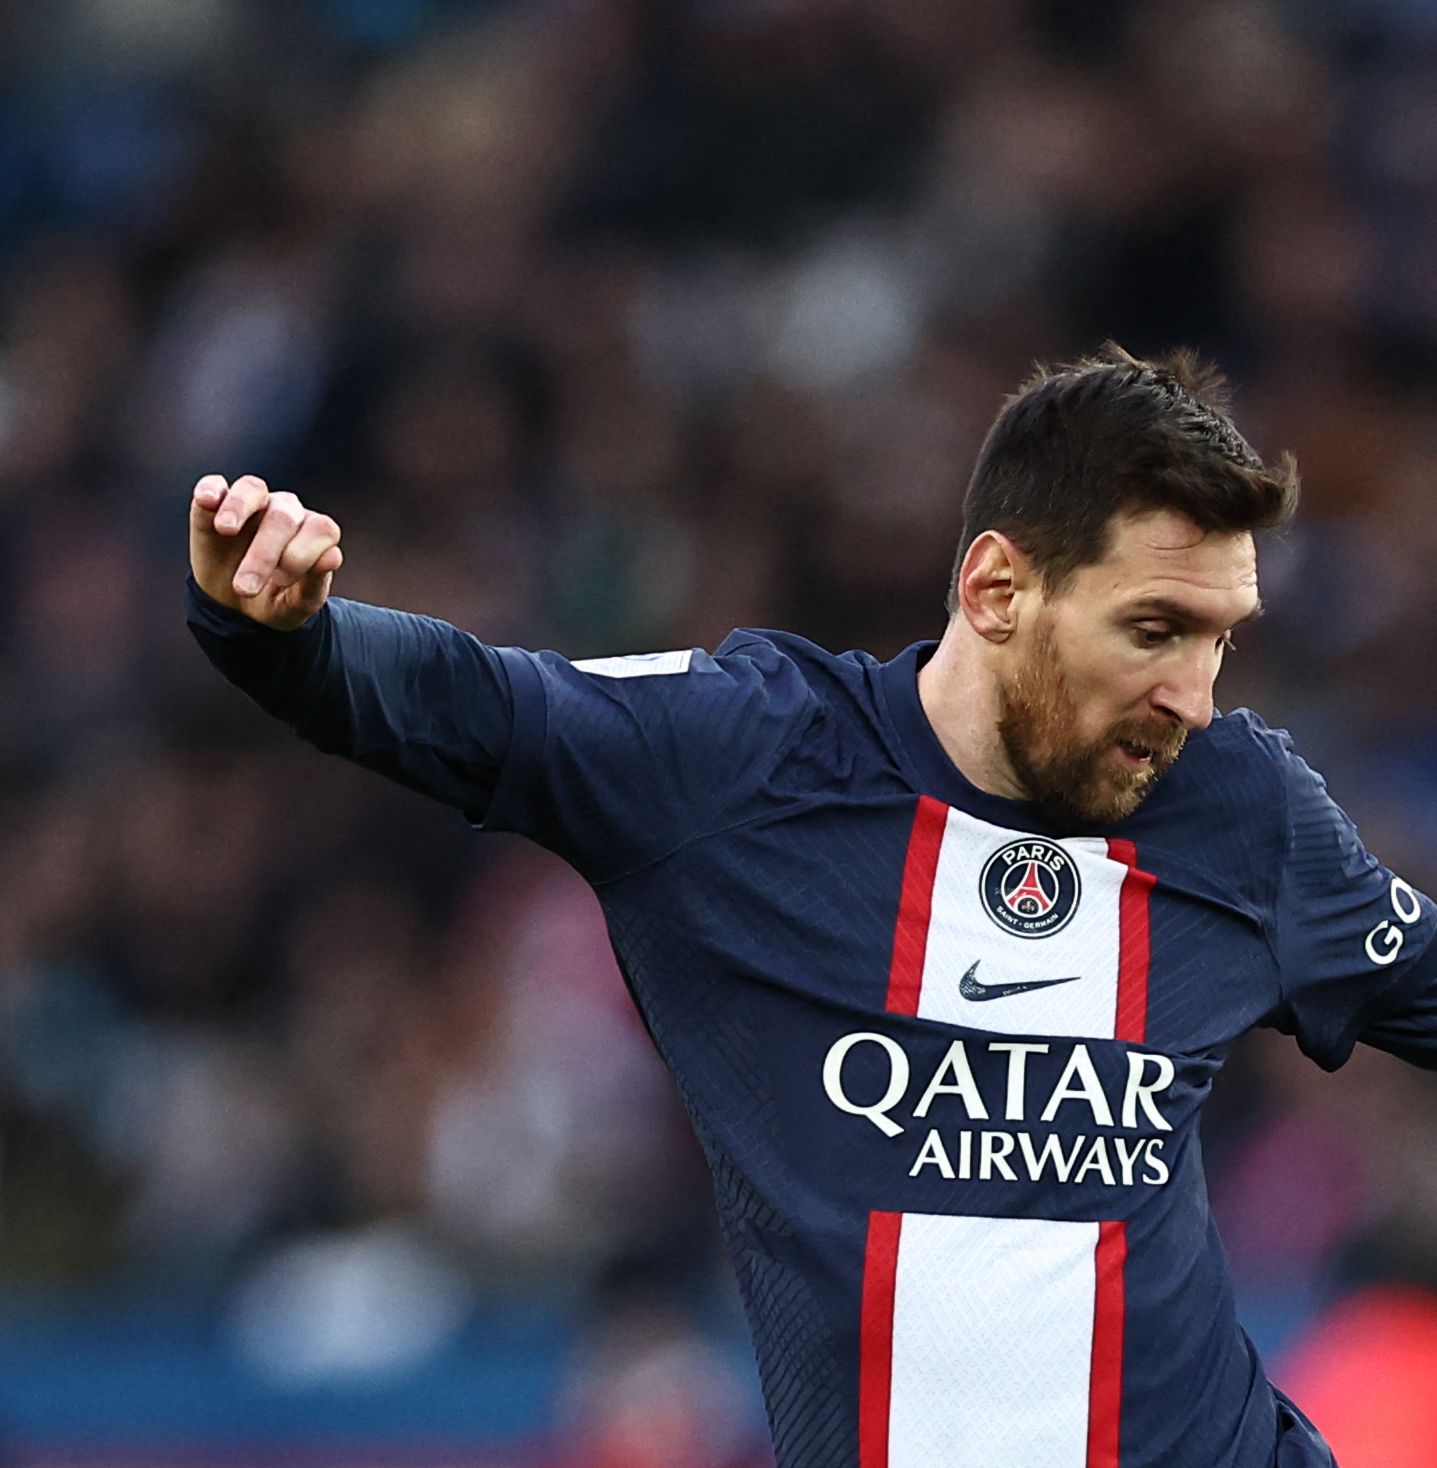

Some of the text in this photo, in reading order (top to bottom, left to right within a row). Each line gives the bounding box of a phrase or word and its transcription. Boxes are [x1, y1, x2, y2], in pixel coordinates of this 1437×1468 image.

[1002, 845, 1065, 871] PARIS
[997, 906, 1059, 929] SAINT GERMAIN
[822, 1031, 1175, 1138] QATAR
[908, 1129, 1170, 1186] AIRWAYS
